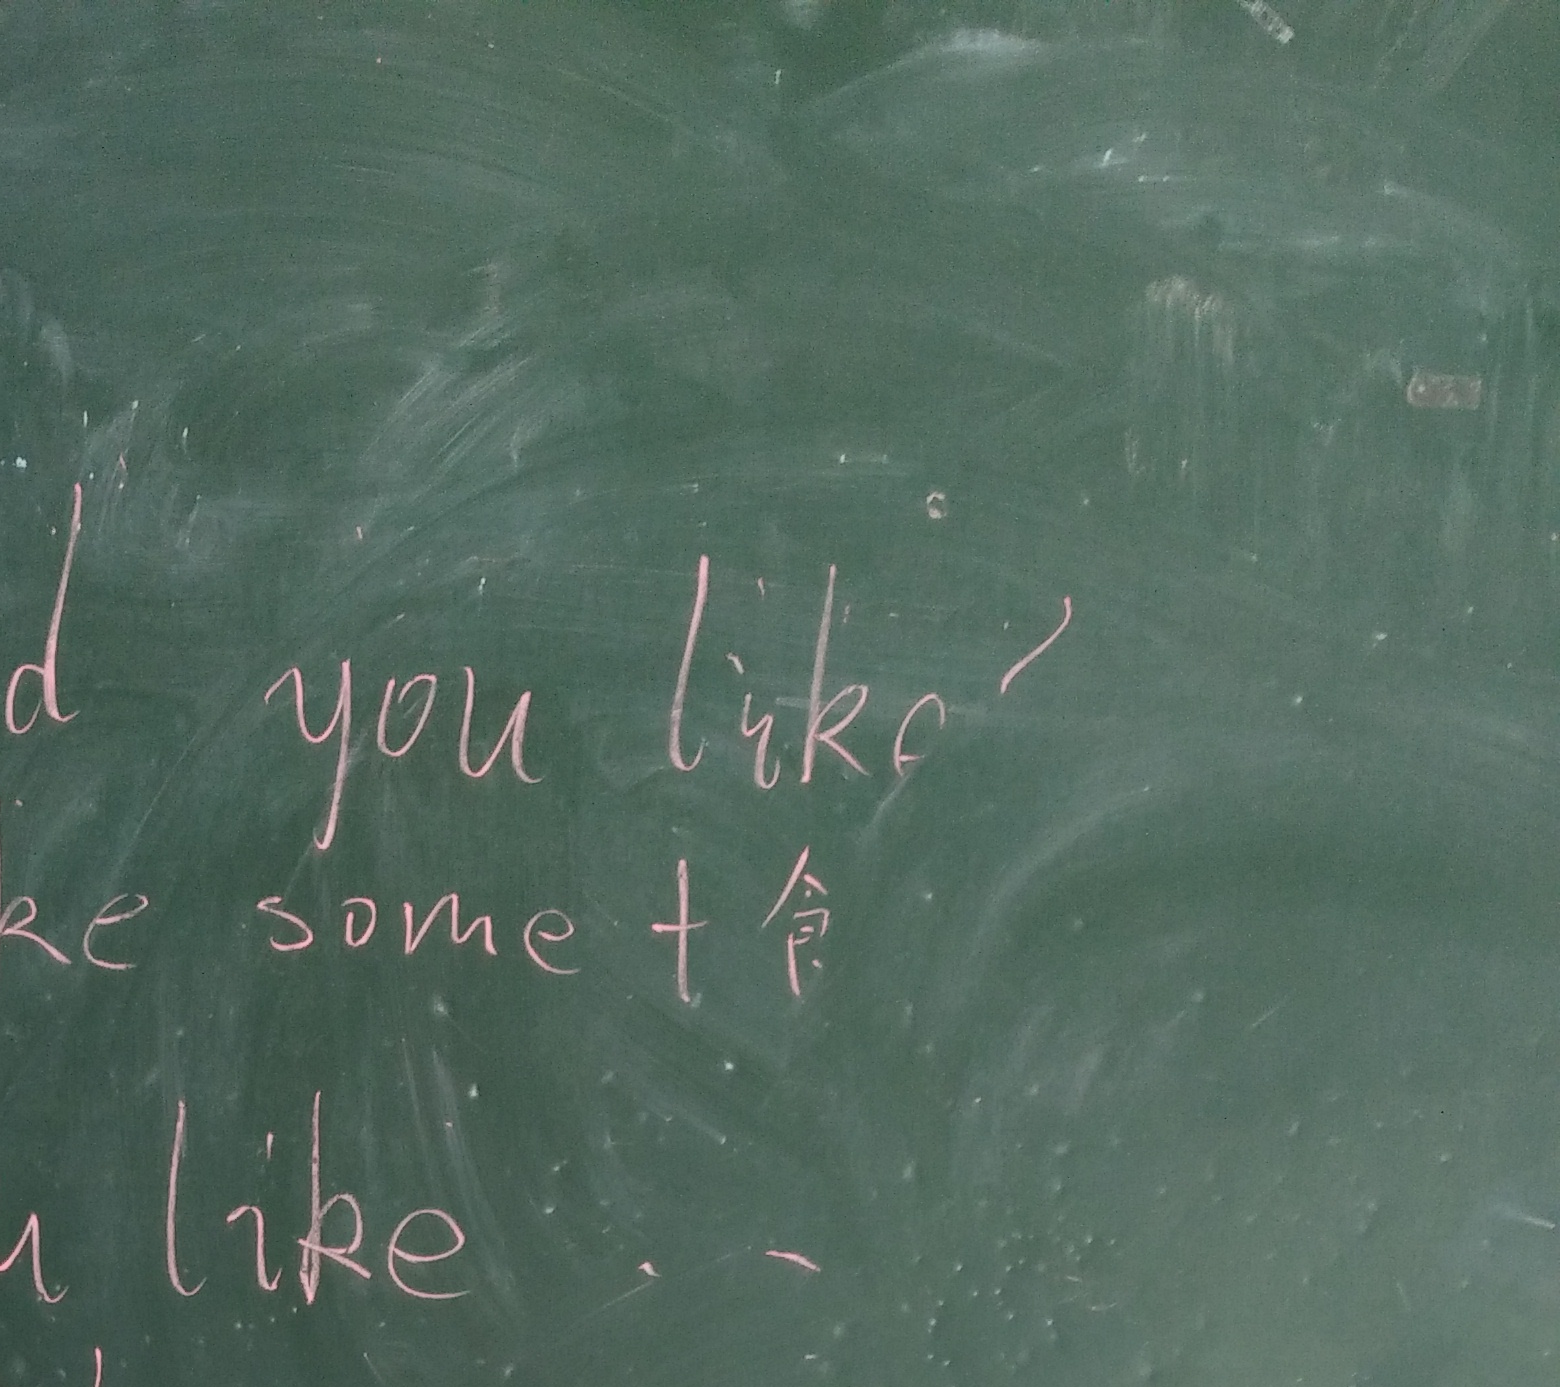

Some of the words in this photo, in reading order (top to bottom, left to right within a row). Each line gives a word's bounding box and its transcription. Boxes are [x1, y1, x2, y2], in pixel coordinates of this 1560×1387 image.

[262, 656, 545, 850] you
[255, 892, 582, 974] some
[162, 1090, 472, 1304] like
